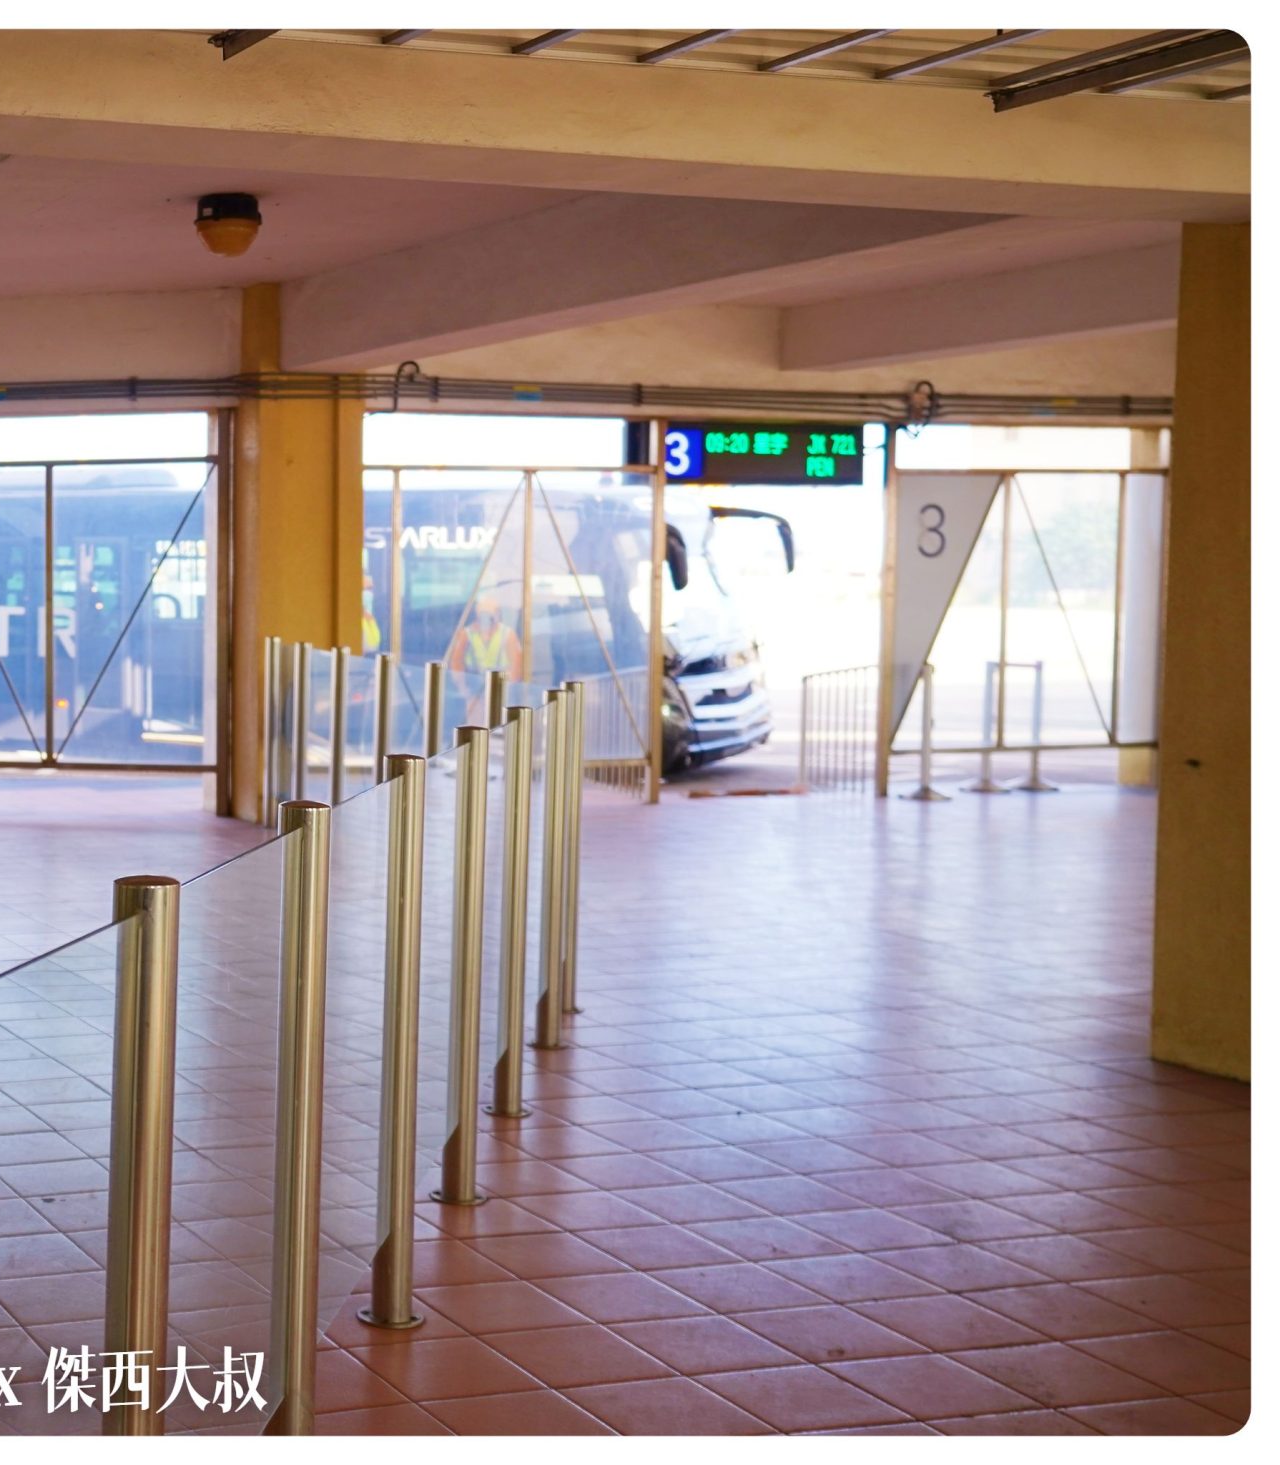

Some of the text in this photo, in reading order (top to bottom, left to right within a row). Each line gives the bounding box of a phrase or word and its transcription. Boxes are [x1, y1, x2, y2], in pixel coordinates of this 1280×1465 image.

[664, 431, 690, 476] 3
[806, 456, 835, 477] PEN
[364, 525, 498, 550] SARLUX
[918, 503, 946, 558] 3
